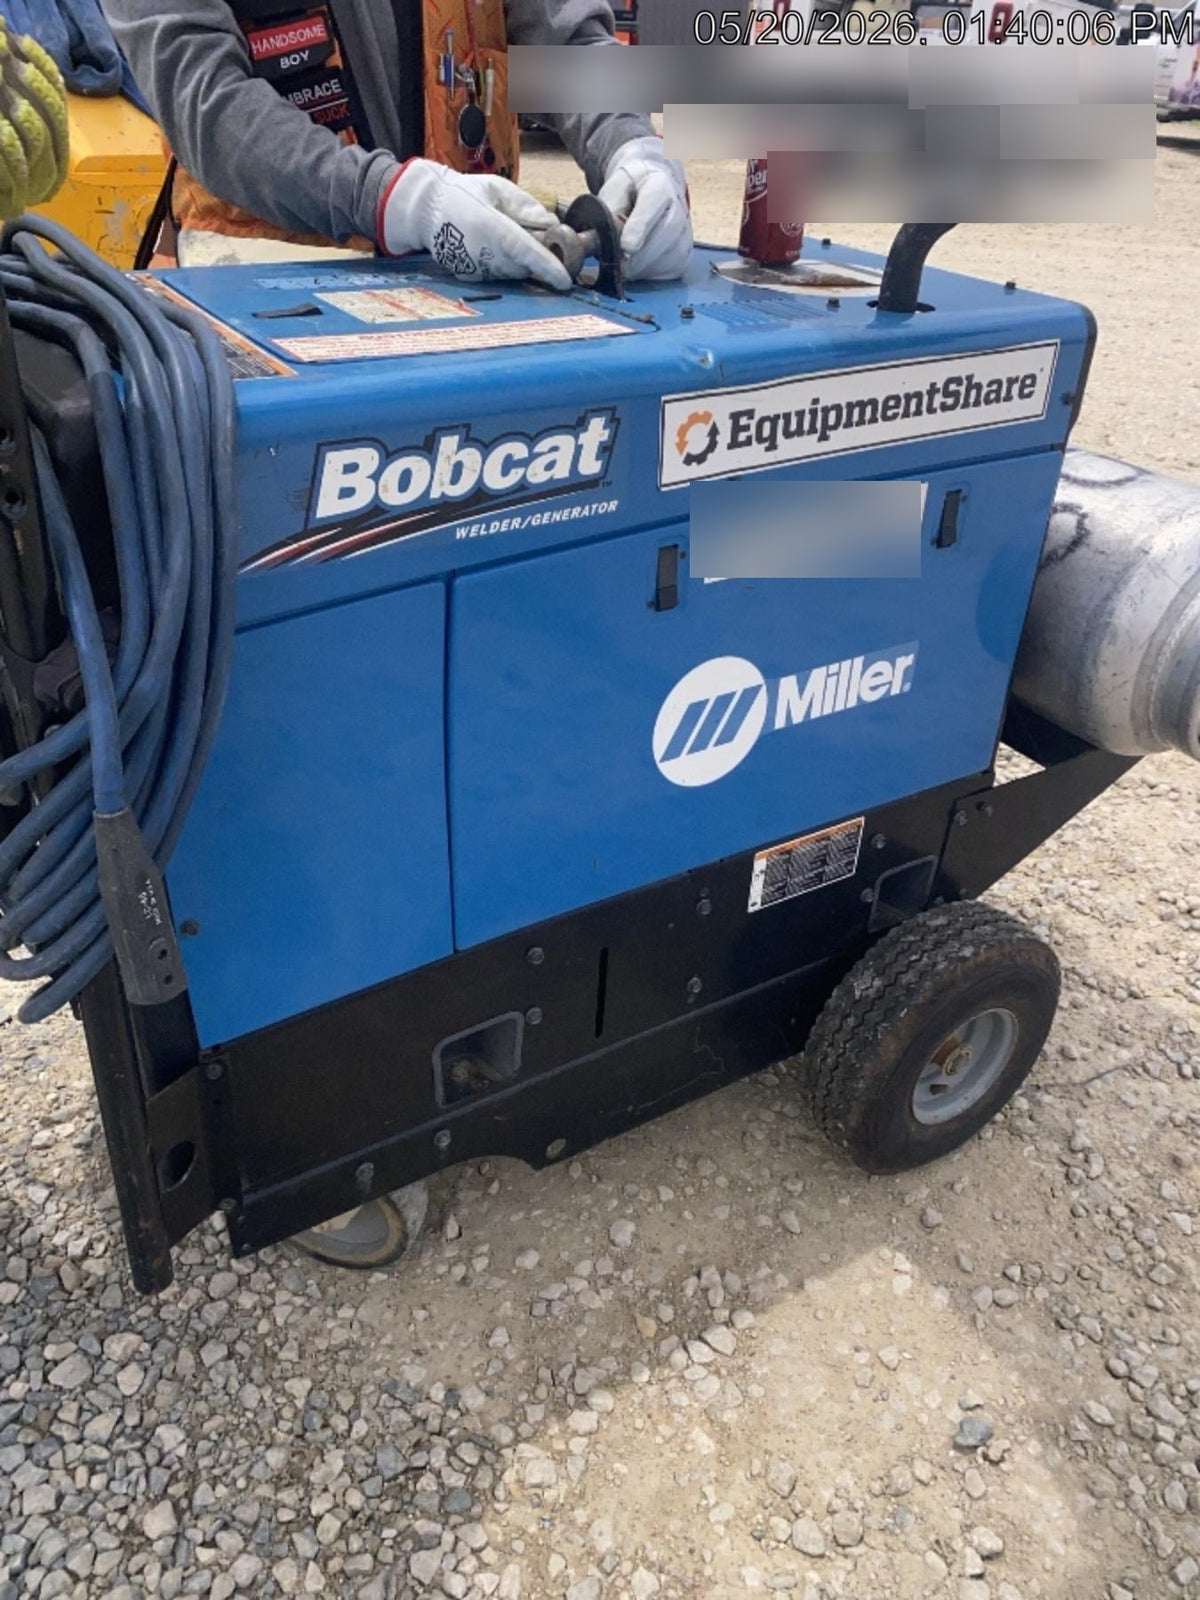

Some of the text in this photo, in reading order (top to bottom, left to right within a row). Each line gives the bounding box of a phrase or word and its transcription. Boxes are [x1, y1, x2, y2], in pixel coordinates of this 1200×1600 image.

[250, 24, 326, 54] HANDSOME
[280, 49, 310, 69] BOY
[287, 78, 343, 105] BRACE
[726, 371, 1038, 453] EquipmentShare
[316, 416, 611, 519] Bobcat
[454, 499, 619, 540] WELDER/GENERATOR
[774, 653, 915, 730] Miller
